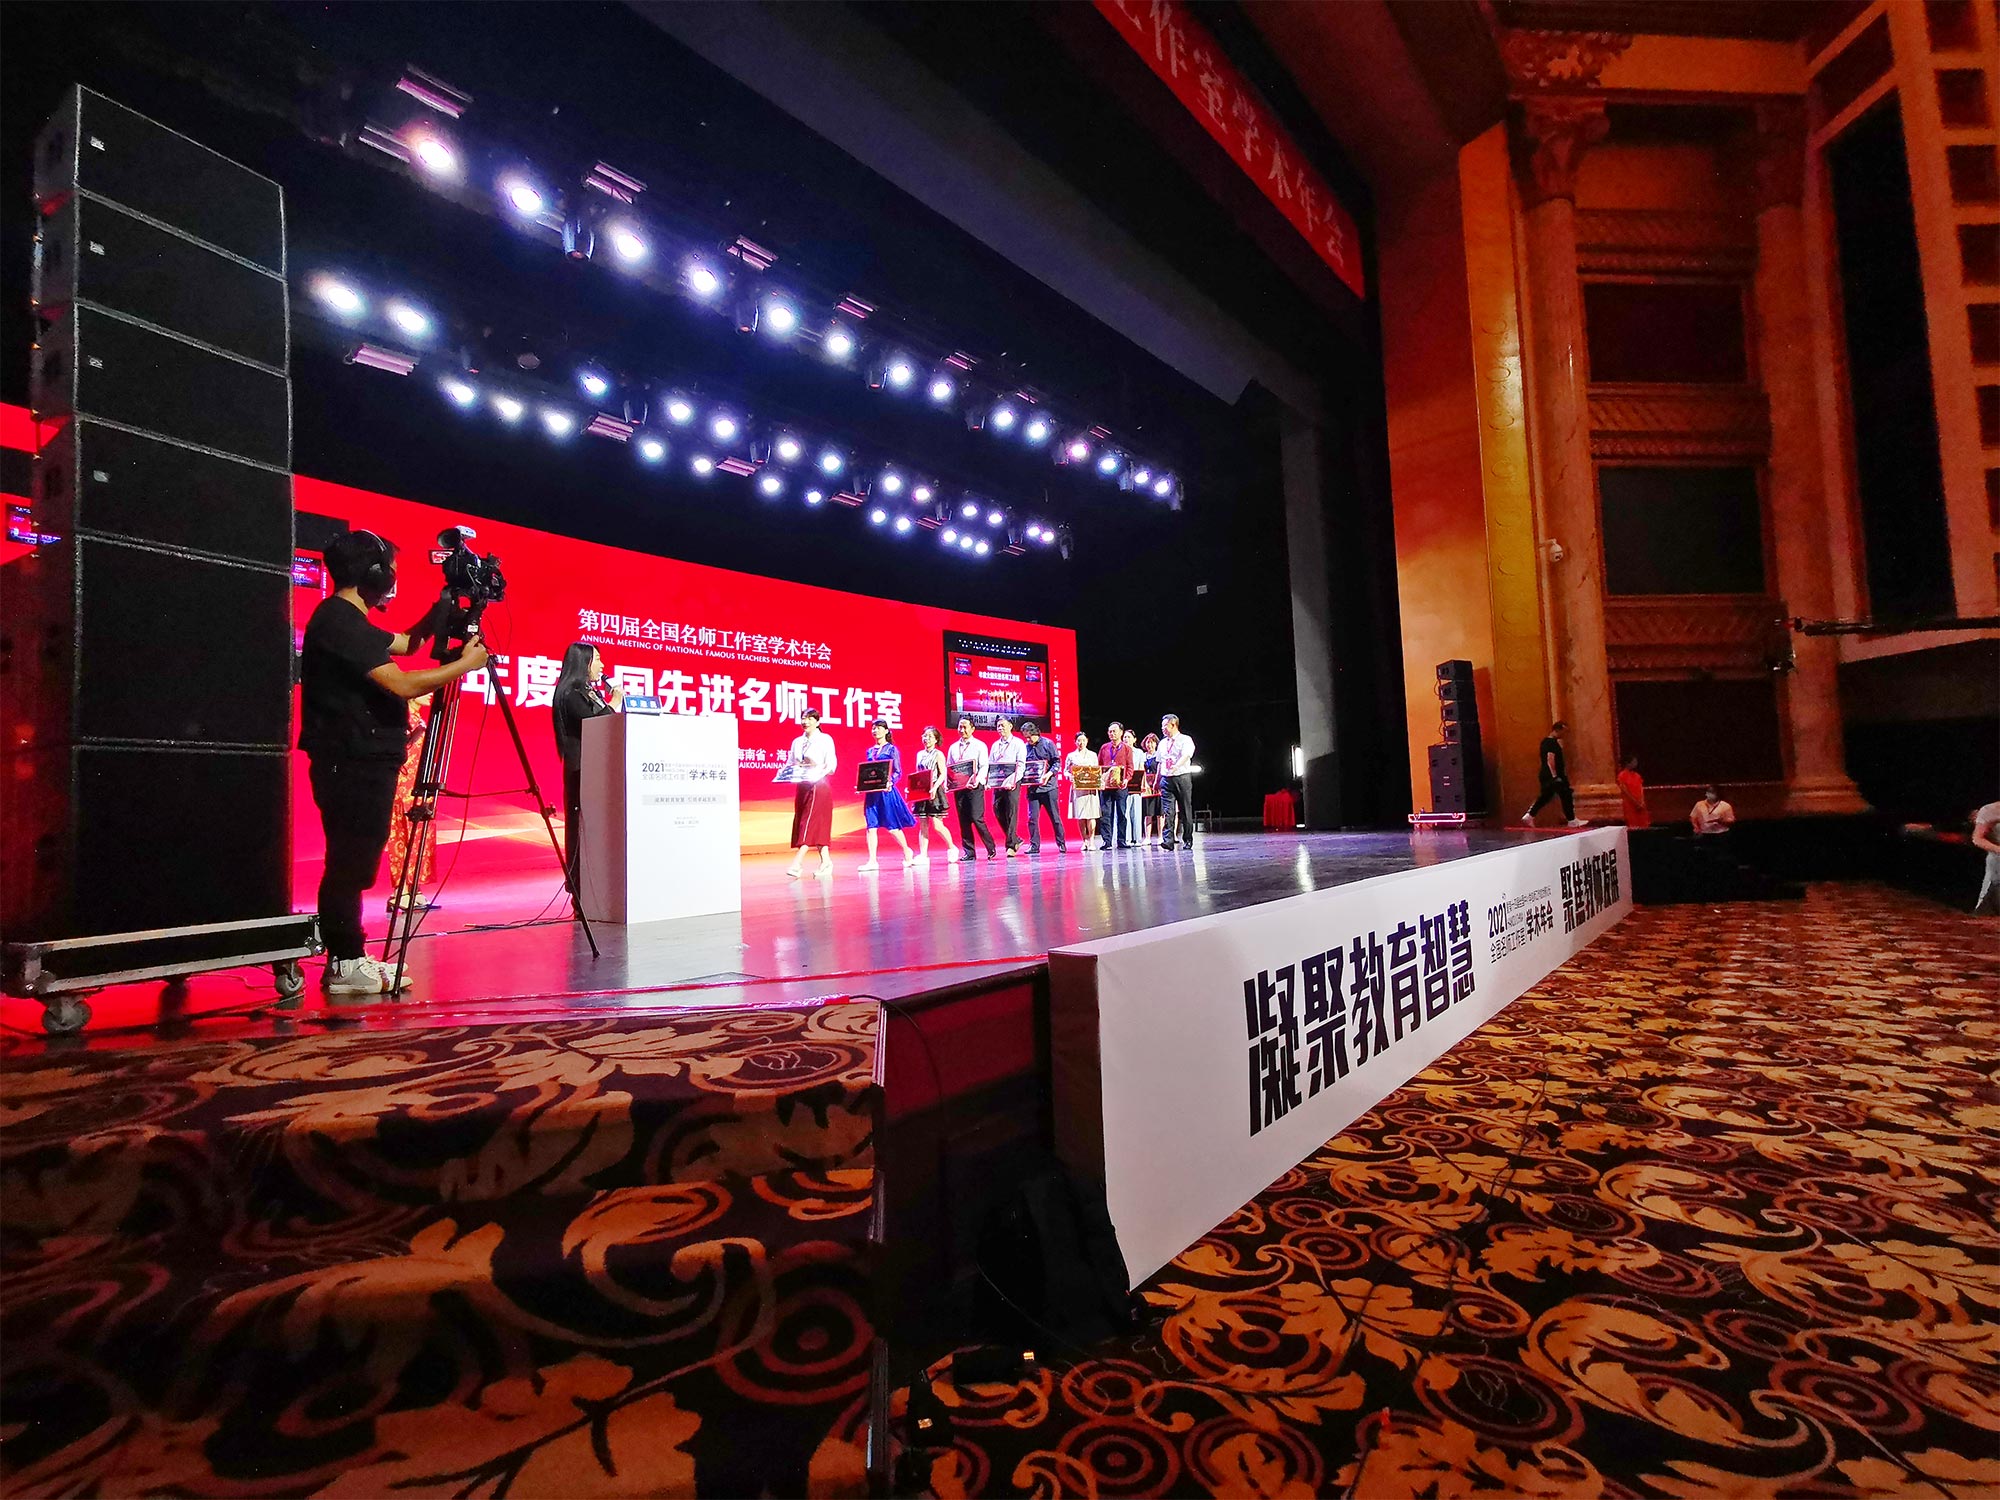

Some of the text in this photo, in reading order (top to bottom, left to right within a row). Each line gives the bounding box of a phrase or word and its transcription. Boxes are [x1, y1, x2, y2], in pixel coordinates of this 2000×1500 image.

[577, 608, 832, 661] 第四届全国名师工作室学术年会
[580, 634, 831, 670] ANNUAL MEETING OF NATIONAL FAMOUS TEACHERS WORKSHOP UNION
[460, 654, 903, 730] 年度国先进名师工作室
[642, 762, 665, 773] 2021
[689, 769, 727, 781] 学术年会
[1488, 902, 1508, 939] 2021
[1526, 900, 1553, 941] 学术年会
[1243, 899, 1476, 1138] 凝聚教育智慧
